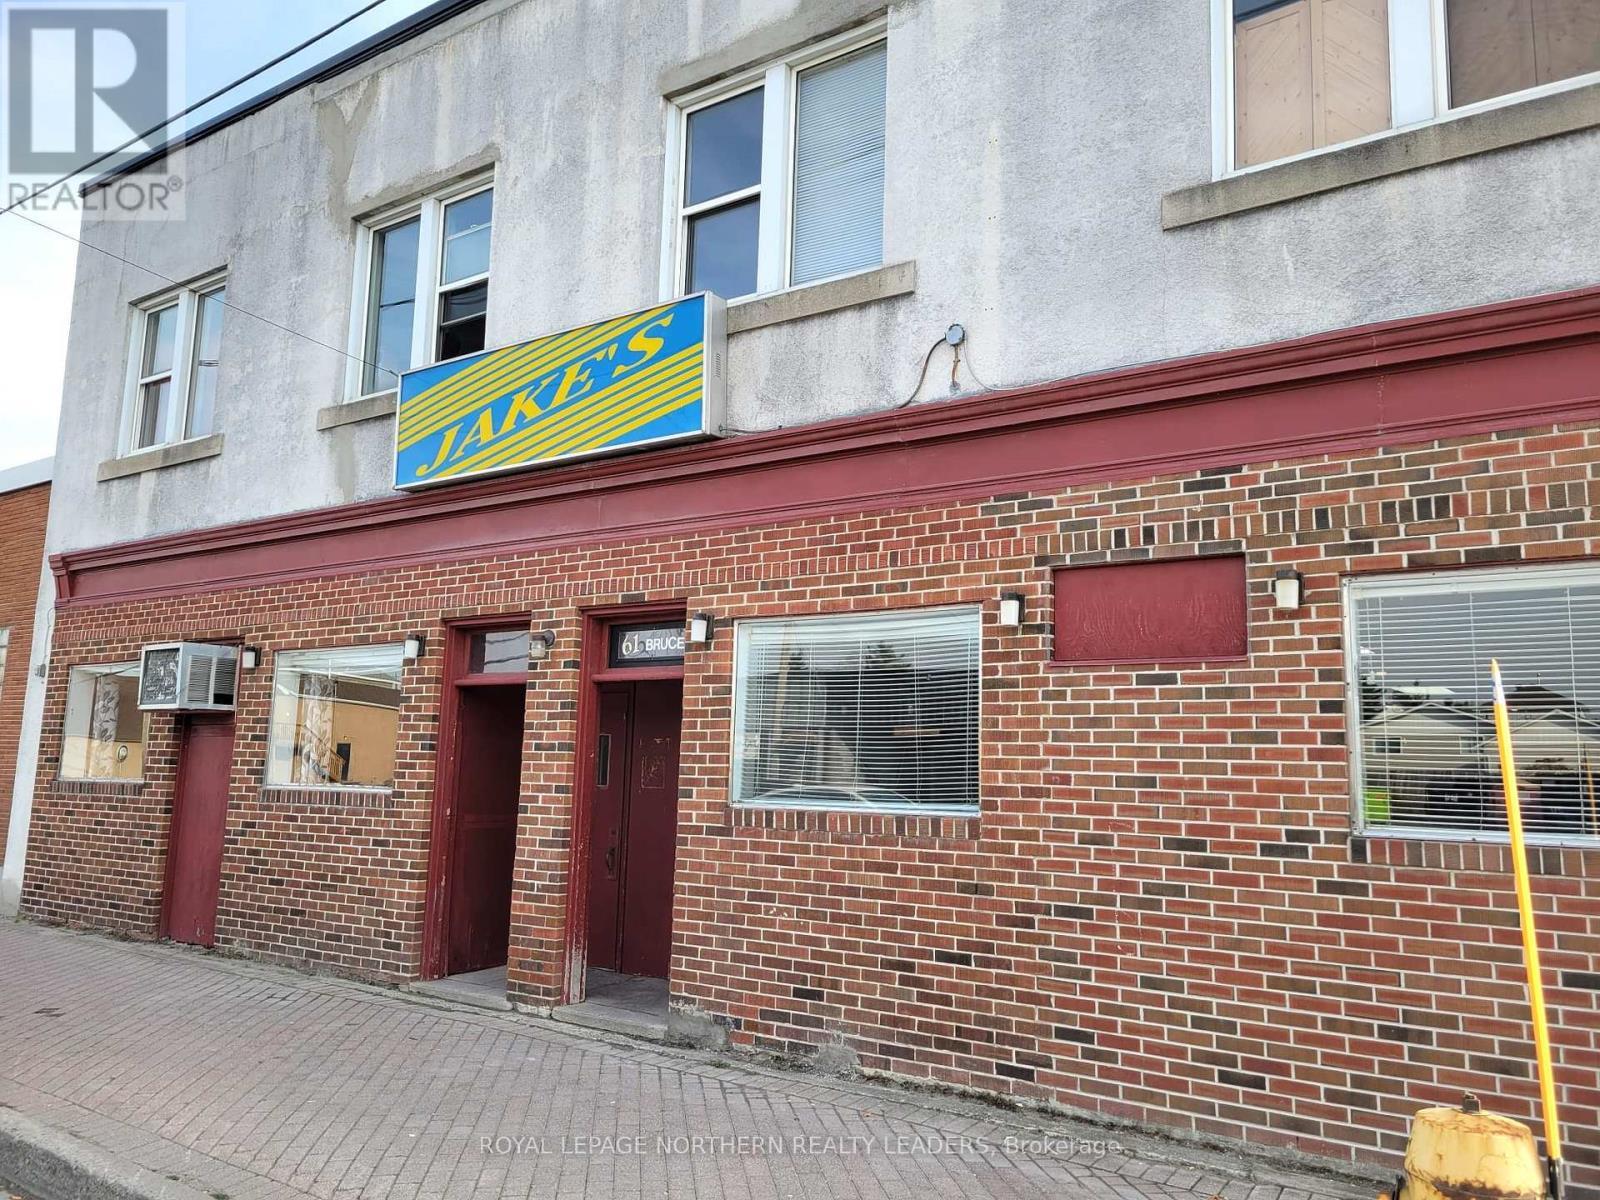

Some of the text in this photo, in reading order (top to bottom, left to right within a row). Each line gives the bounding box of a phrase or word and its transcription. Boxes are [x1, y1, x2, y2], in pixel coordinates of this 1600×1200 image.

[415, 313, 675, 477] JAKE'S
[622, 633, 685, 656] 61 BRUCE
